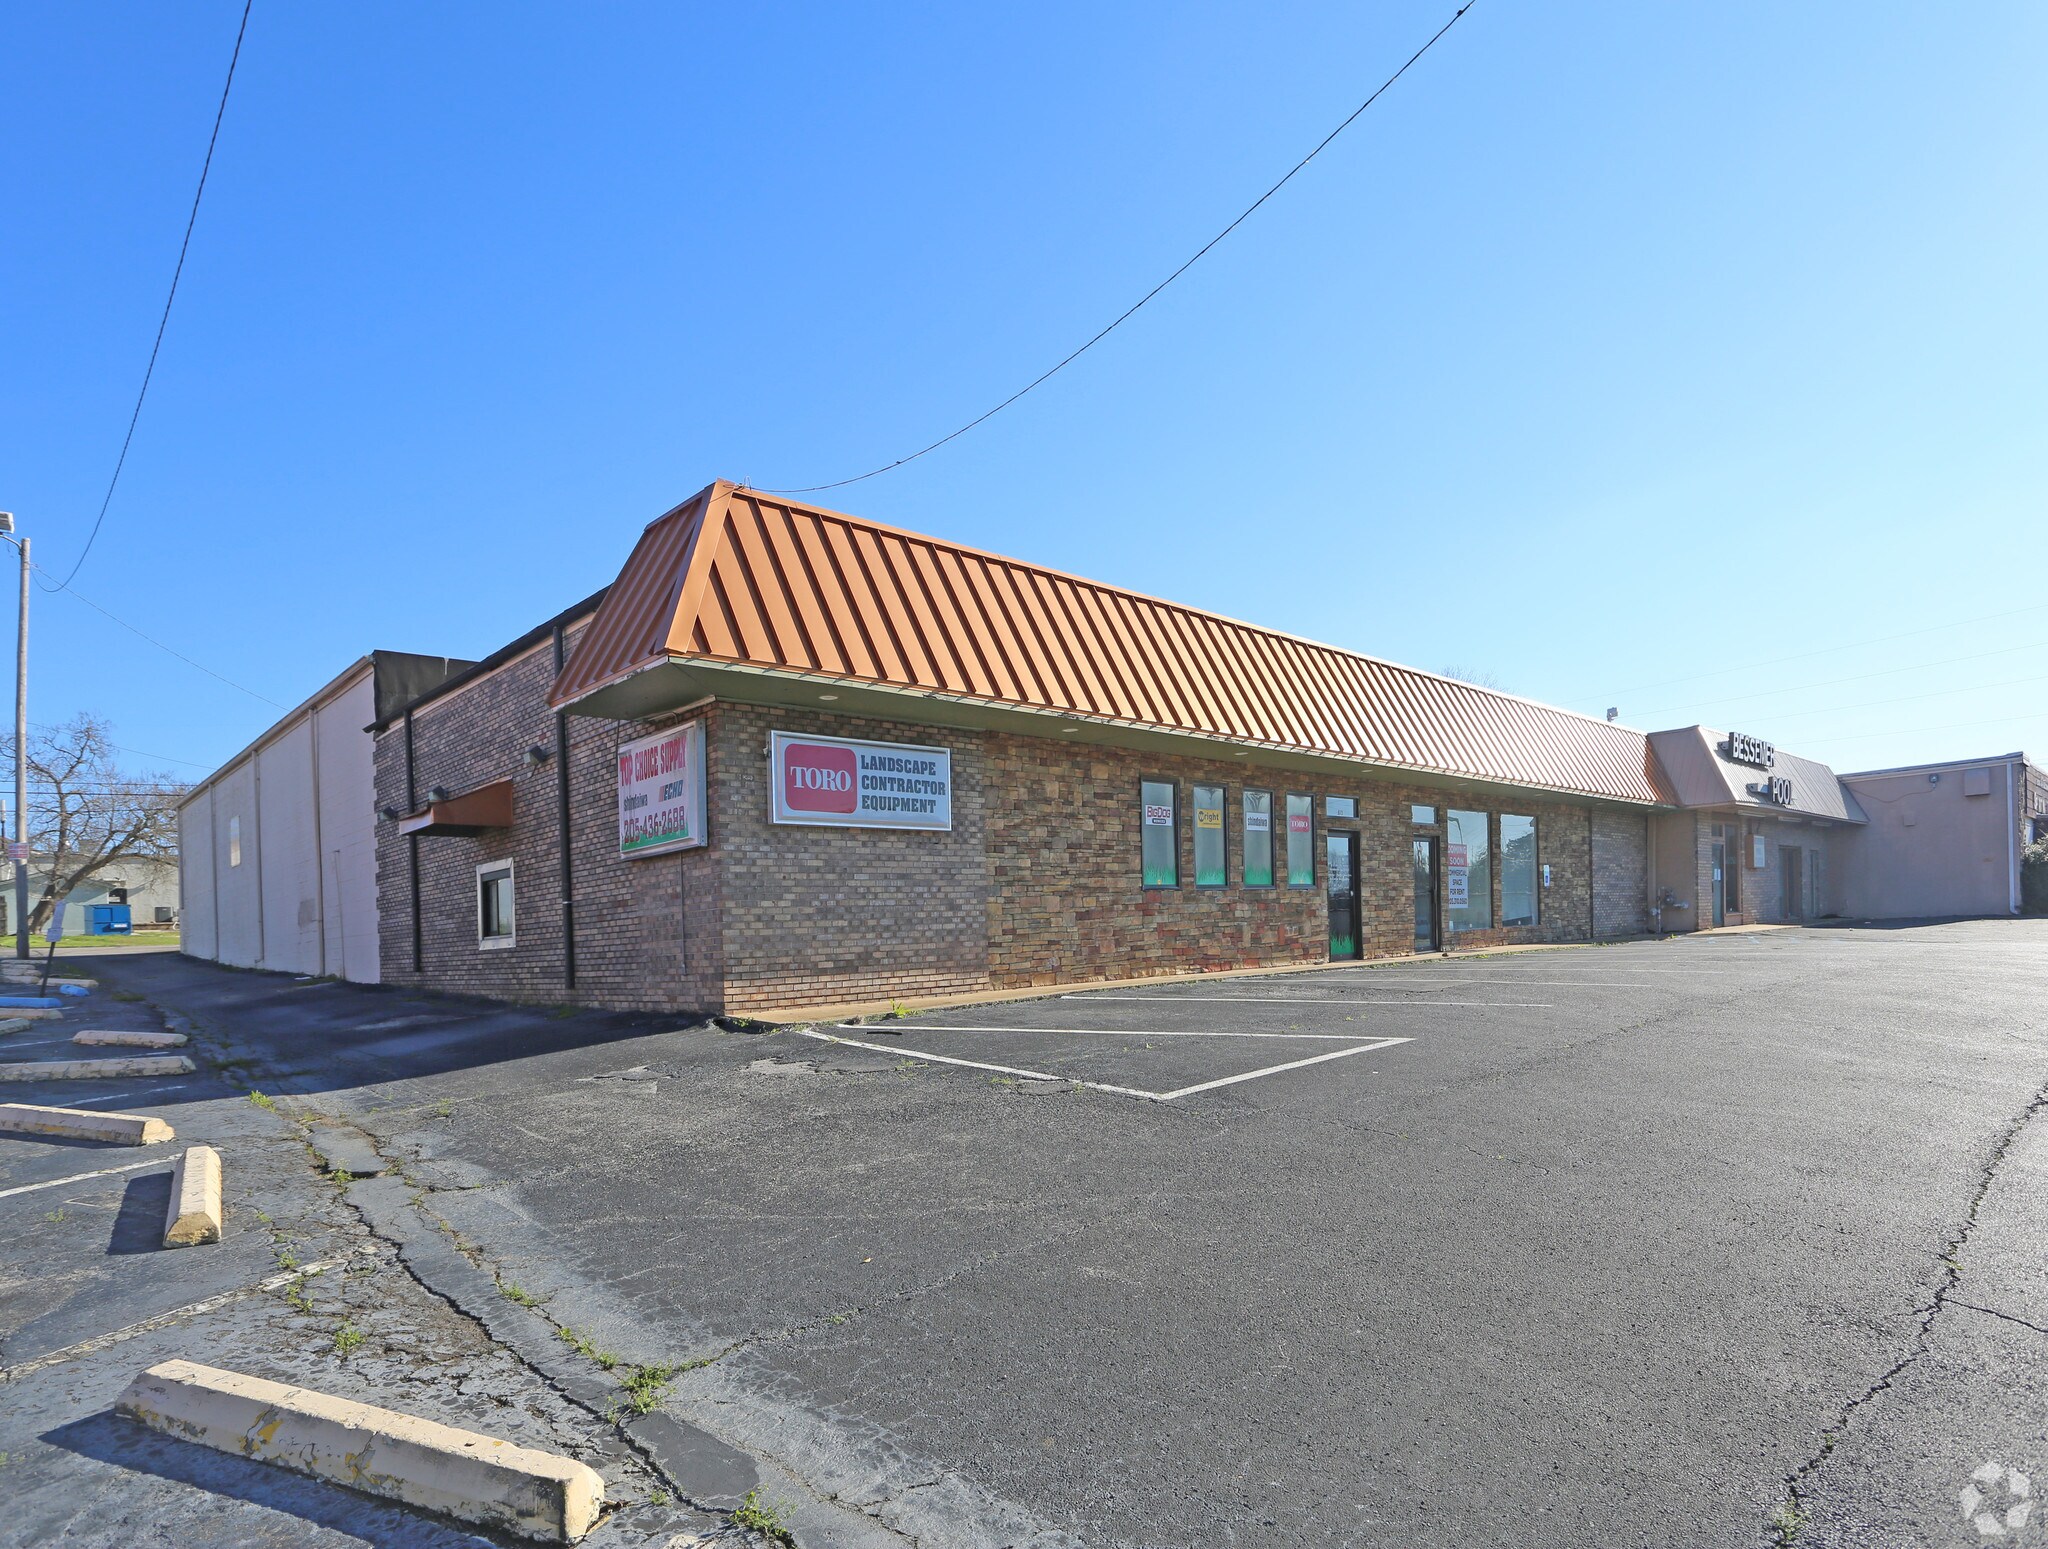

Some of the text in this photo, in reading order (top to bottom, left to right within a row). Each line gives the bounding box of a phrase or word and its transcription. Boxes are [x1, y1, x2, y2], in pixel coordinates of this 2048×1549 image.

[1732, 732, 1775, 767] BESSEMER
[619, 735, 687, 787] TOP CHOICE SUPPLY
[860, 755, 936, 776] LANDSCAPE
[790, 766, 852, 792] TORO
[861, 775, 946, 796] CONTRACTOR
[663, 779, 684, 801] ECHO
[861, 795, 937, 814] EQUIPMENT
[623, 805, 685, 844] 205-436-2688
[1198, 811, 1220, 823] Wright
[1291, 820, 1308, 828] TORO
[1449, 857, 1465, 866] SOON
